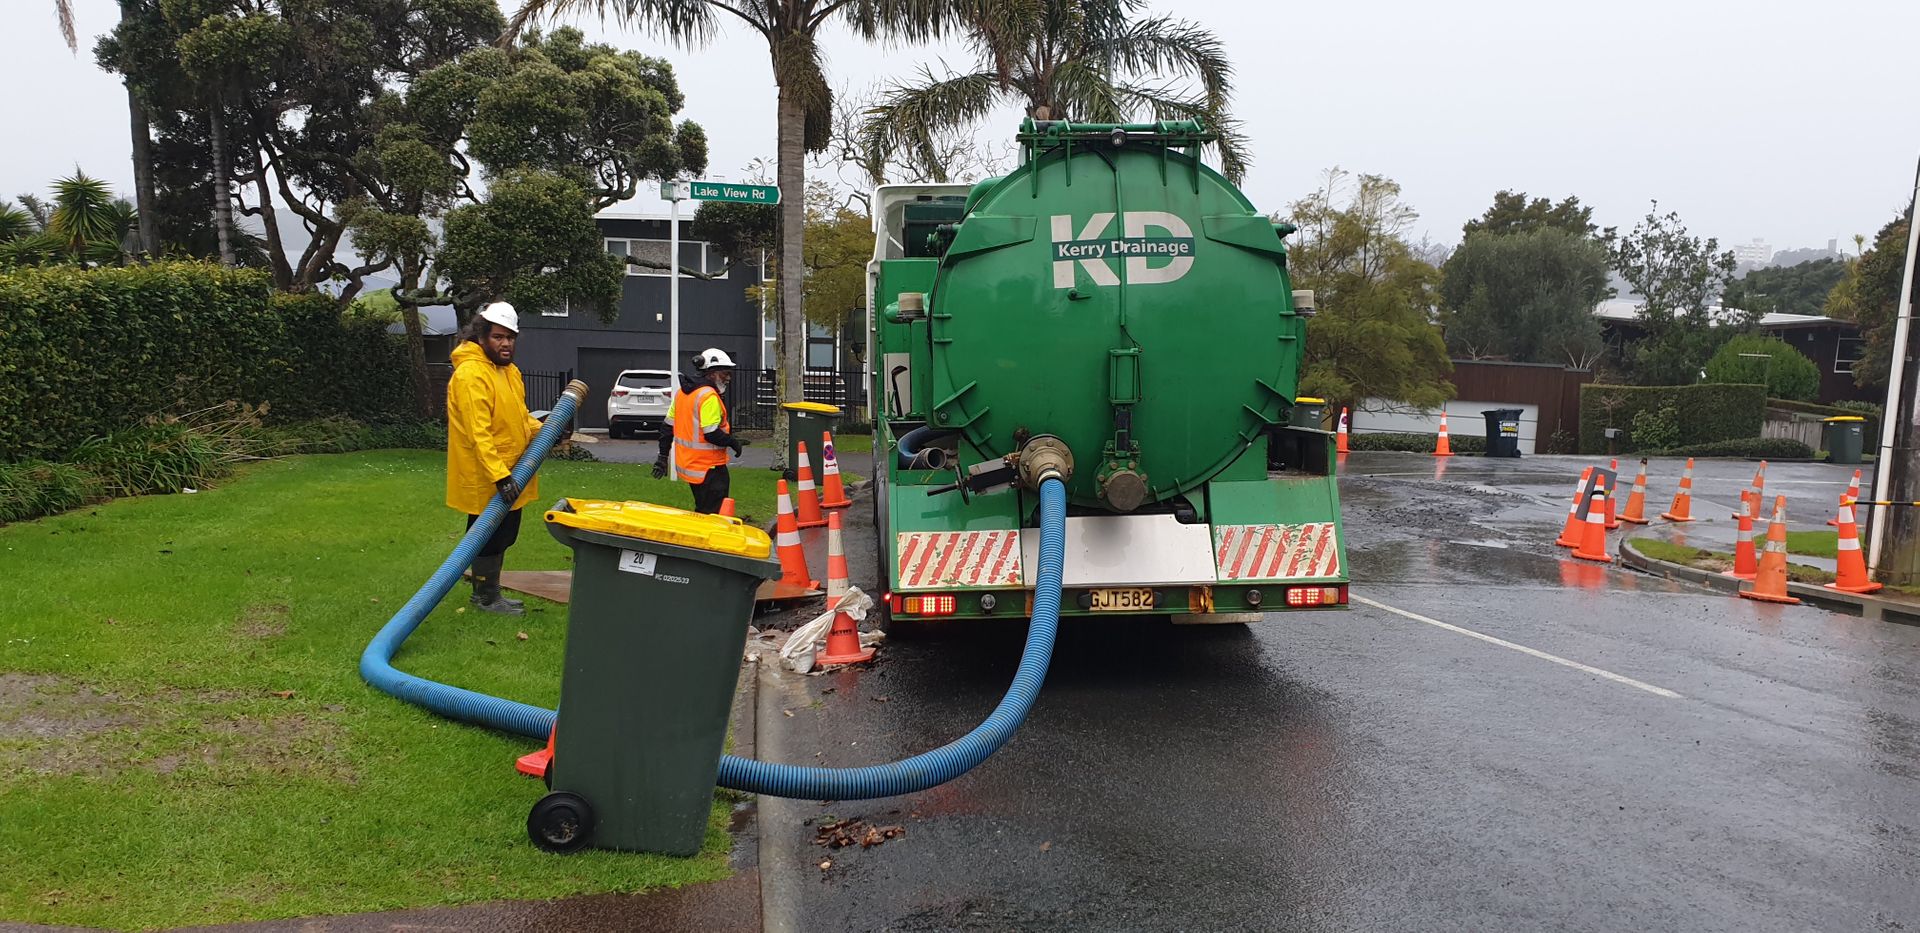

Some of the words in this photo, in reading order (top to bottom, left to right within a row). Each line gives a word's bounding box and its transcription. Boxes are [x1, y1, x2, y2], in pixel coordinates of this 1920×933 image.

[694, 186, 719, 197] Lake
[723, 187, 748, 199] View
[752, 189, 765, 200] Rd
[1050, 211, 1195, 289] KD
[1058, 243, 1106, 258] Kerry
[1111, 239, 1189, 256] Drainage
[633, 552, 645, 565] 20
[1090, 590, 1152, 607] GJT582
